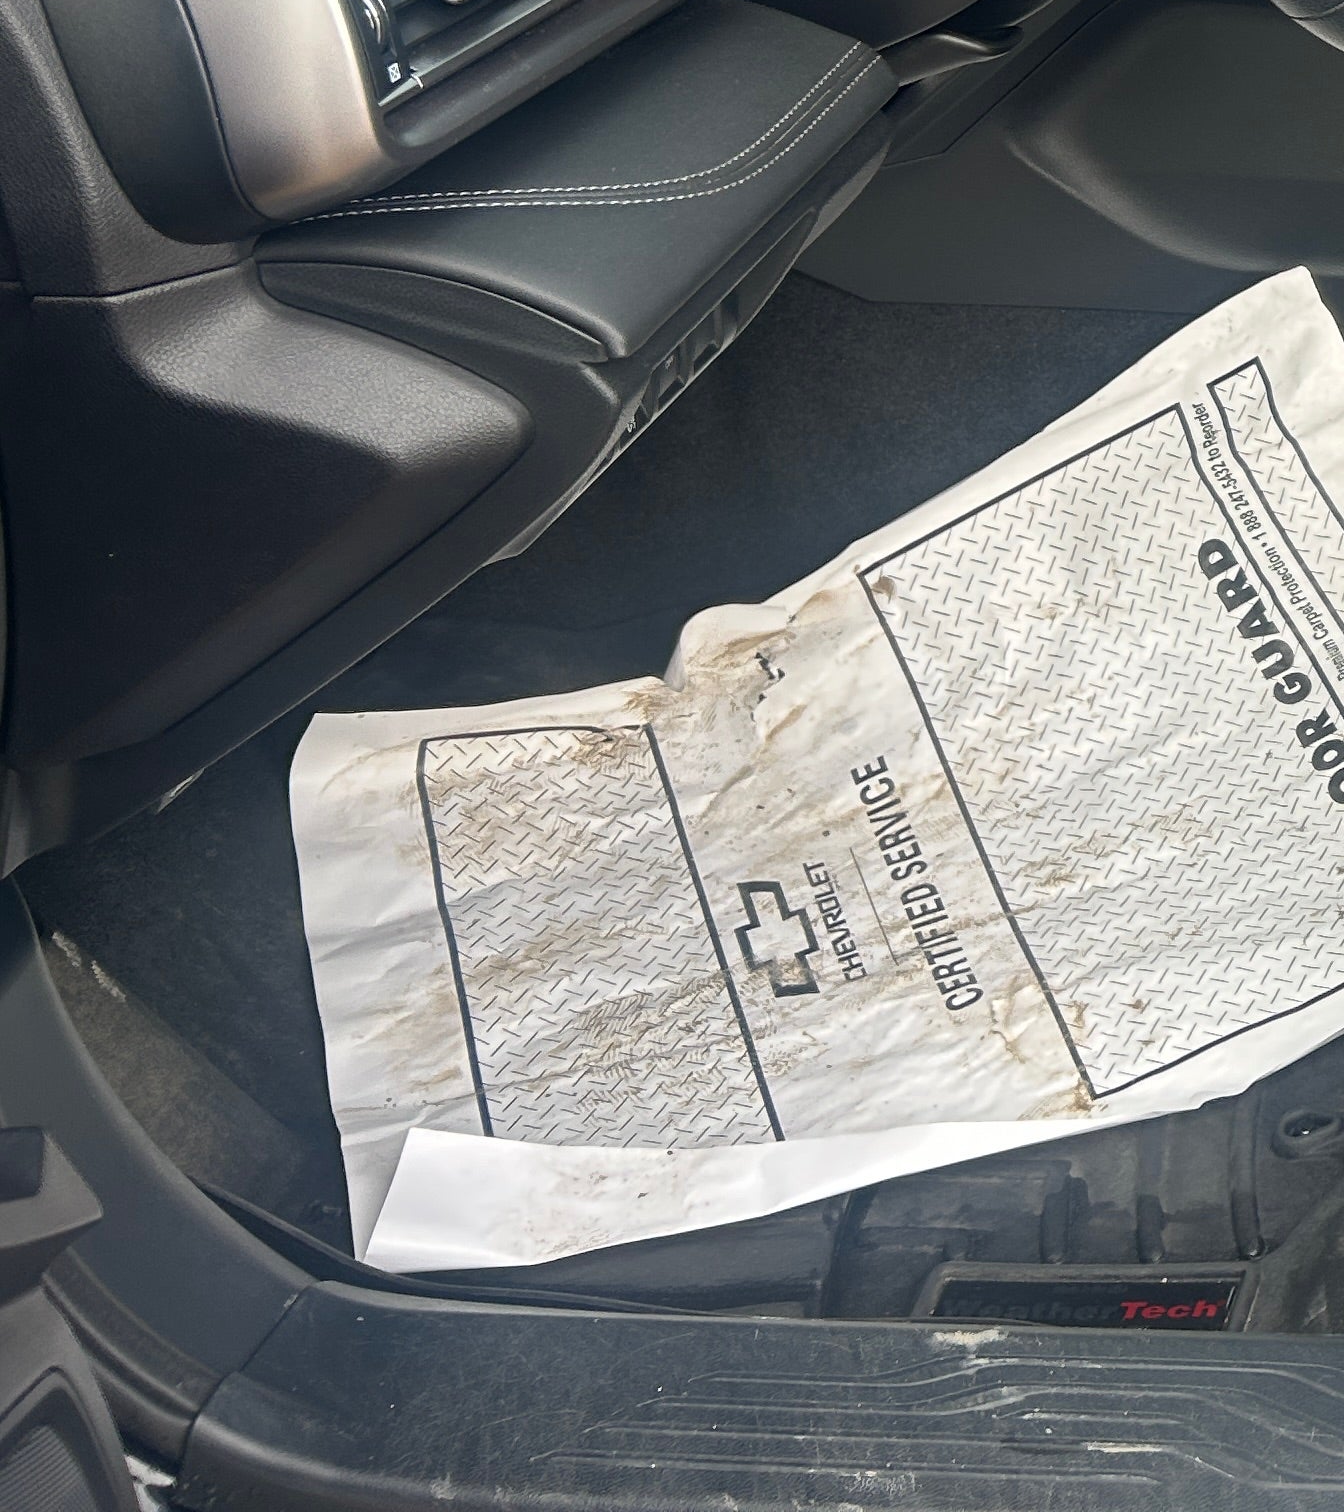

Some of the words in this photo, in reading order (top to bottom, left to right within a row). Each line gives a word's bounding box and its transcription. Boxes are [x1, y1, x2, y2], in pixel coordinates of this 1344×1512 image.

[1191, 402, 1218, 449] Reorder
[1207, 447, 1222, 462] to
[1210, 460, 1250, 511] 247-5432
[1239, 510, 1262, 533] 888
[1251, 531, 1267, 541] 1
[1264, 546, 1303, 605] Protection
[1197, 538, 1313, 705] GUARD
[1296, 596, 1329, 641] Carpet
[850, 755, 928, 881] SERVICE
[802, 861, 868, 982] CHEVROLET
[900, 882, 984, 1011] CERTIFIED
